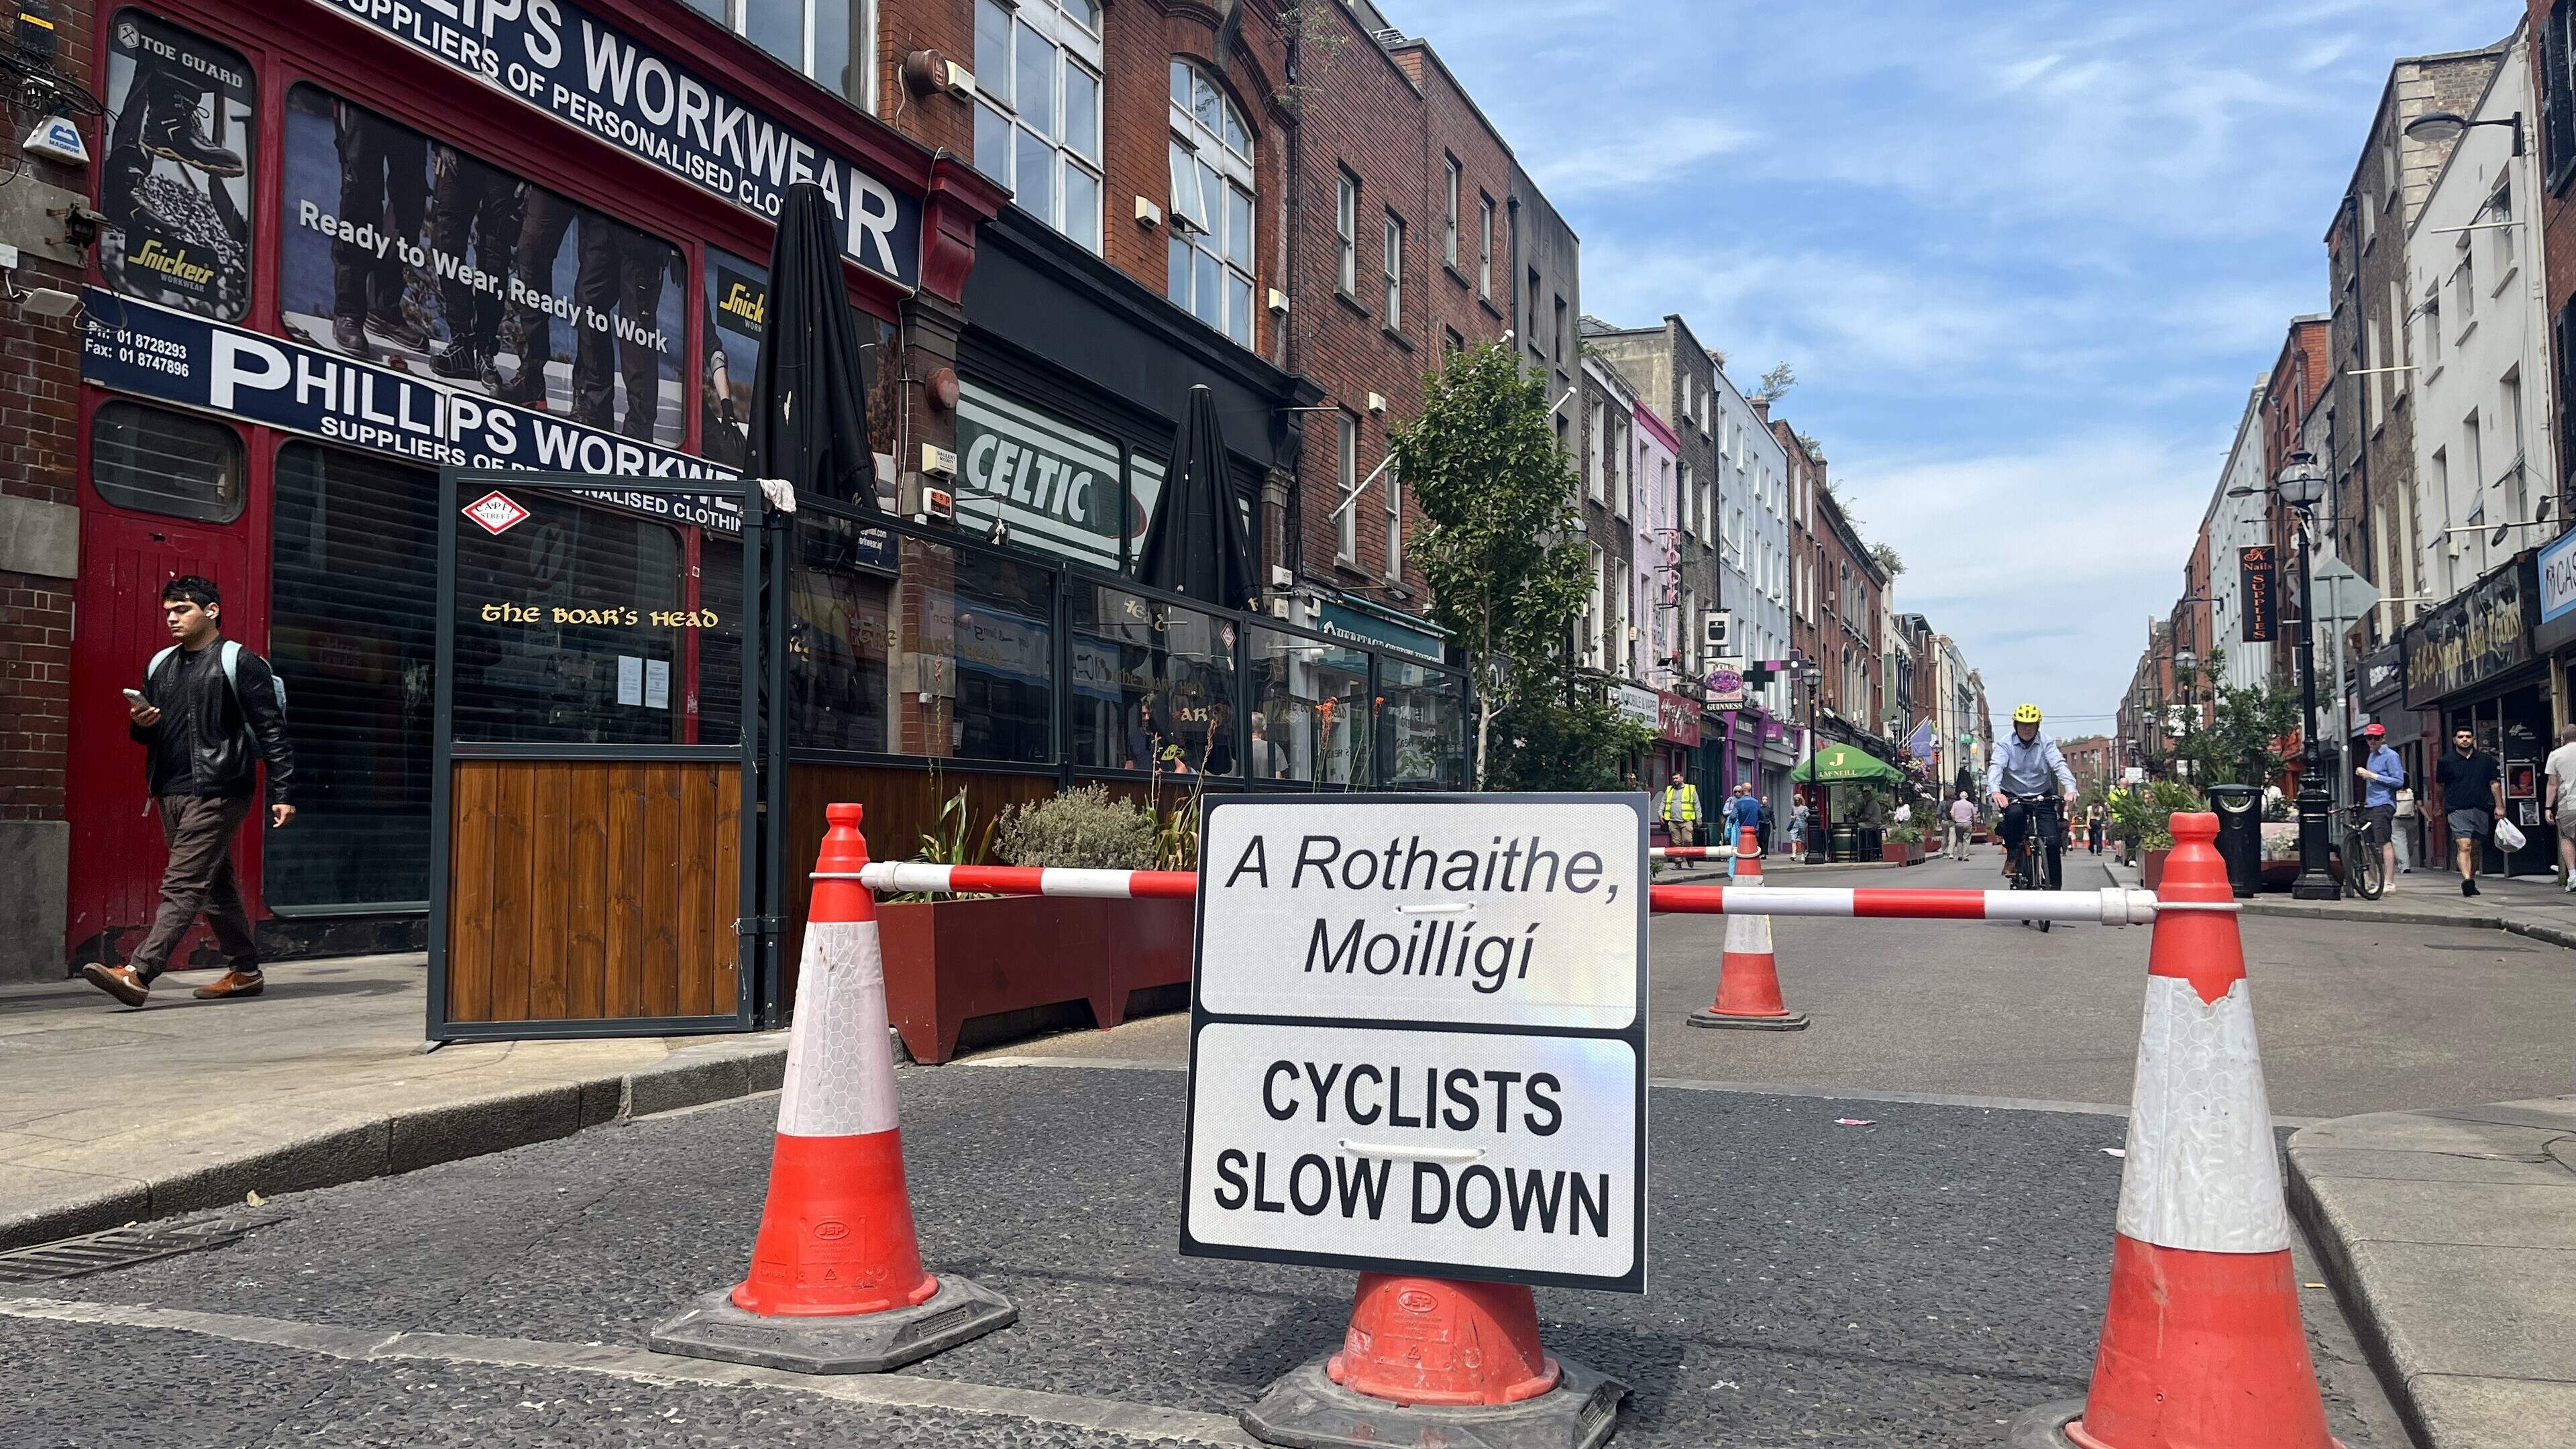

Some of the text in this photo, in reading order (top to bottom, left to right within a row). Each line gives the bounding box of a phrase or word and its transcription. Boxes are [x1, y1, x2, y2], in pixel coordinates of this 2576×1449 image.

[140, 34, 243, 89] TOE GUARD
[49, 139, 79, 154] MAGNUM
[507, 62, 545, 98] OF
[552, 83, 733, 193] PERSONALISED
[581, 19, 900, 277] WORKWEAR
[127, 239, 215, 284] Snickers
[160, 272, 205, 292] WORKWEAR
[299, 198, 669, 354] Ready to Wear, Ready to Work
[85, 337, 190, 377] Fax: 01 8747896
[117, 329, 132, 345] 01
[135, 333, 187, 360] 8728293
[210, 329, 518, 455] PHILLIPS
[321, 415, 466, 468] SUPPLIERS
[472, 453, 504, 470] OF
[966, 433, 1093, 523] CELTIC
[2243, 563, 2273, 571] Nails
[2252, 574, 2265, 639] SUPPLIES
[1829, 753, 1846, 766] J
[1224, 834, 1619, 905] A Rothaithe,
[1304, 917, 1542, 994] Moillígí
[1262, 1060, 1563, 1136] CYCLISTS
[1213, 1148, 1610, 1238] SLOW DOWN
[820, 1225, 845, 1236] JSP
